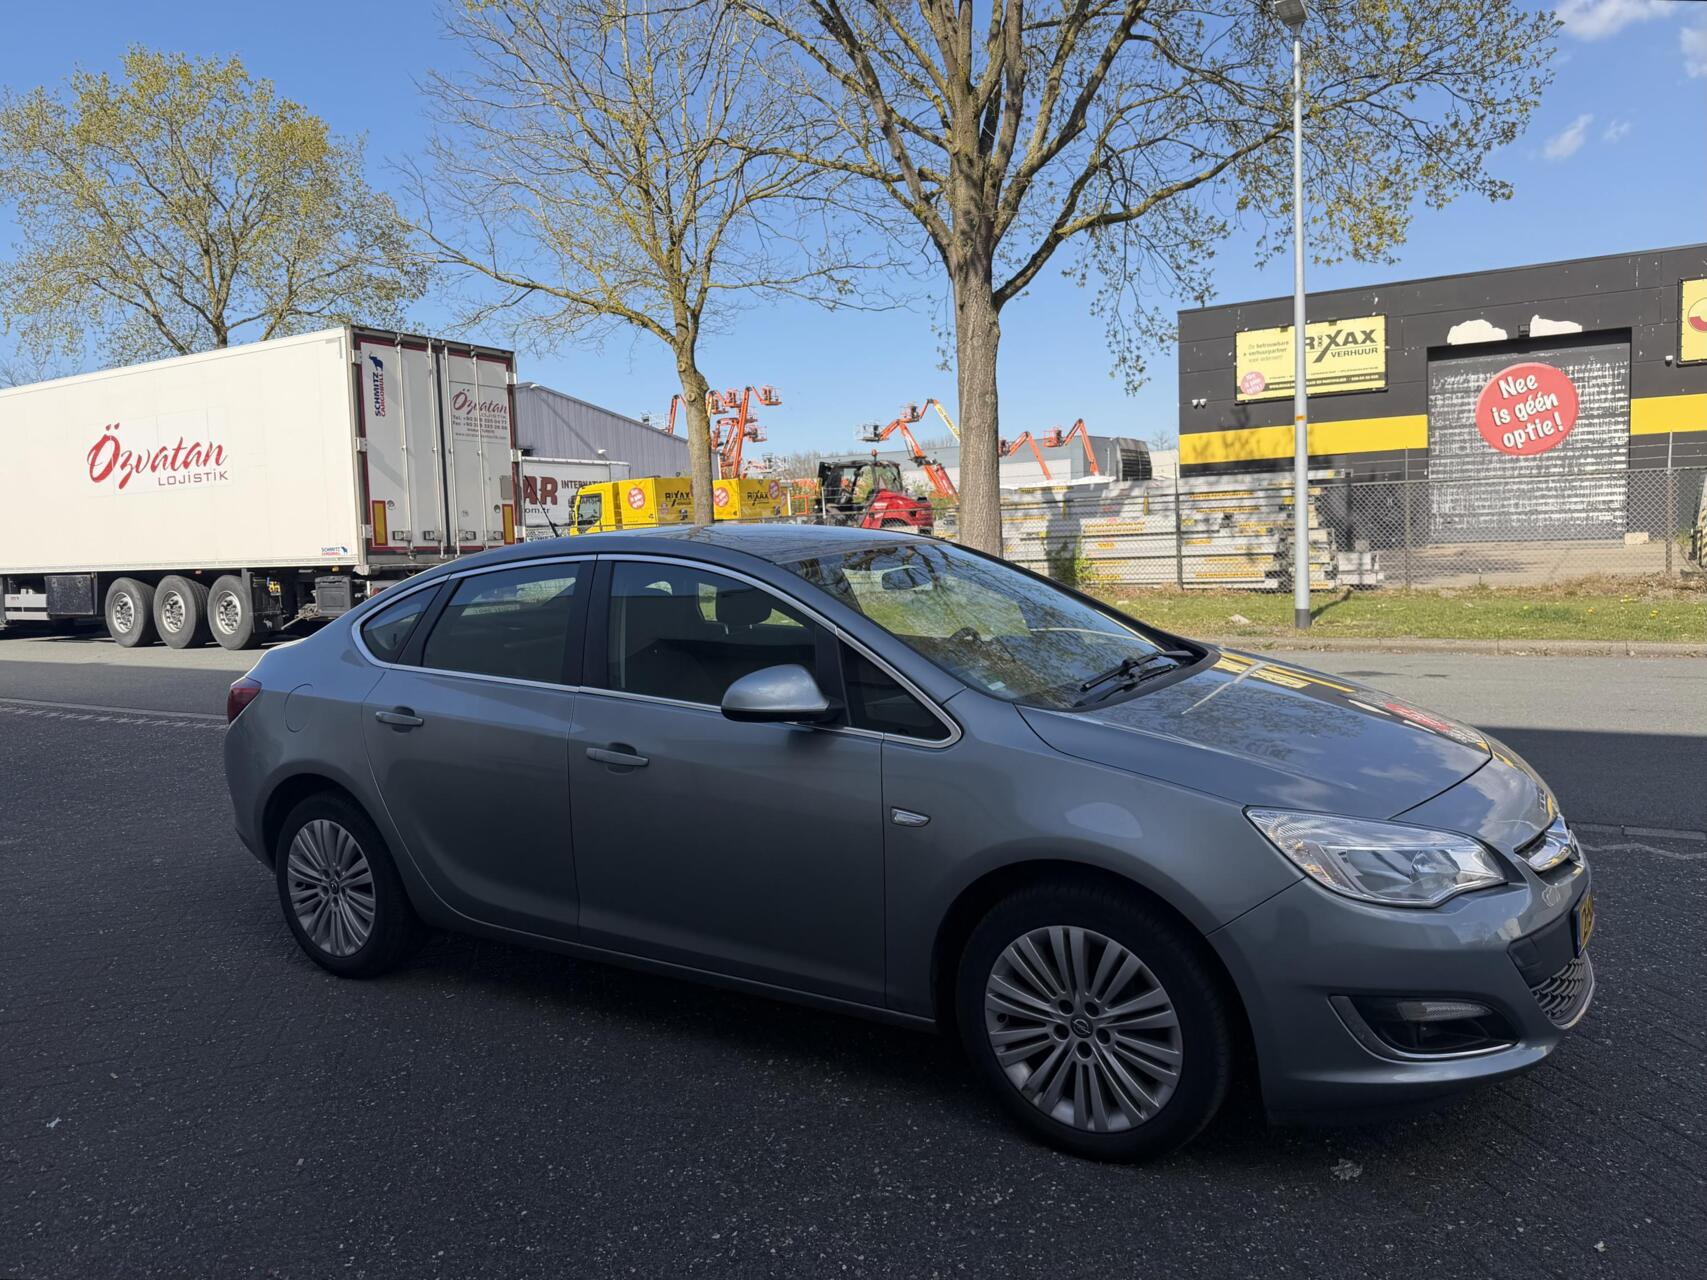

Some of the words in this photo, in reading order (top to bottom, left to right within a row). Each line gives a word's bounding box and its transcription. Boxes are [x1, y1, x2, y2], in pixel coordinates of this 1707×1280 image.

[1331, 347, 1378, 358] VERHUUR
[373, 371, 381, 417] SCHMITZ
[1498, 374, 1538, 399] Nee
[1491, 406, 1511, 426] is
[1514, 391, 1559, 422] géén
[87, 422, 228, 490] Özvatan
